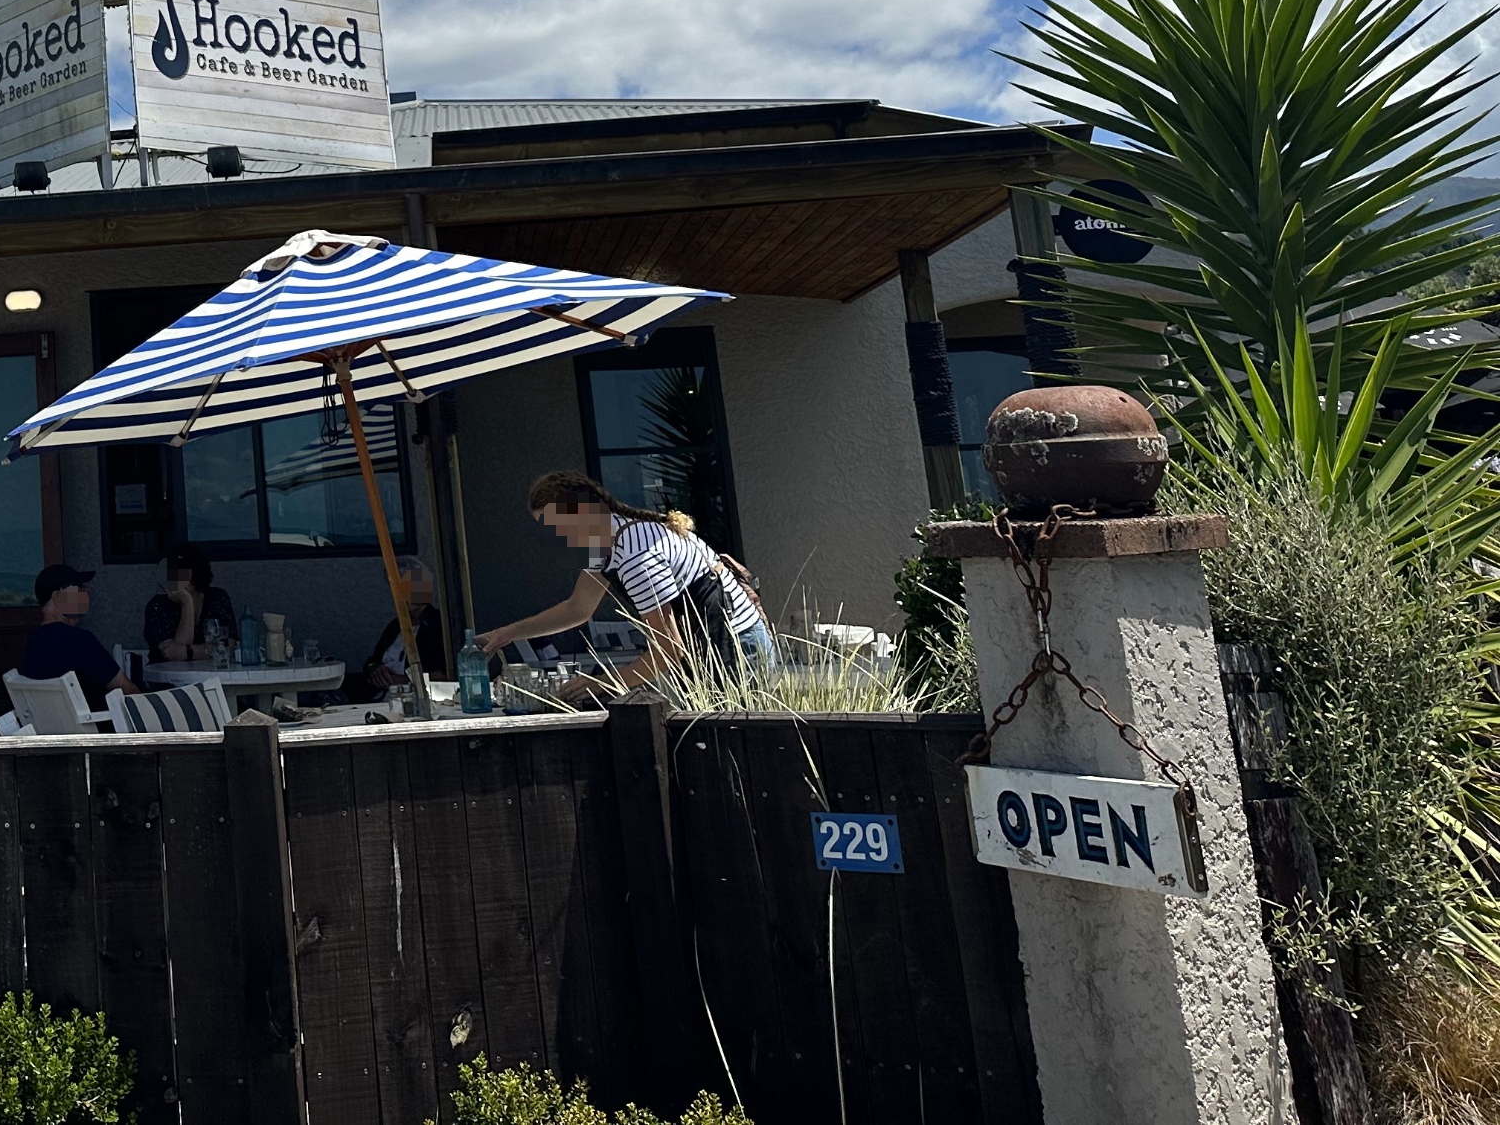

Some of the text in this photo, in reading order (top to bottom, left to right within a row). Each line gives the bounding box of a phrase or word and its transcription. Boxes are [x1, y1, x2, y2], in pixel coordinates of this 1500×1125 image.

[8, 80, 37, 102] Beer
[40, 60, 87, 89] Garden
[196, 53, 369, 93] Cafe & Beer Garden
[1074, 216, 1127, 231] atom
[819, 820, 889, 862] 229
[997, 789, 1156, 874] OPEN
